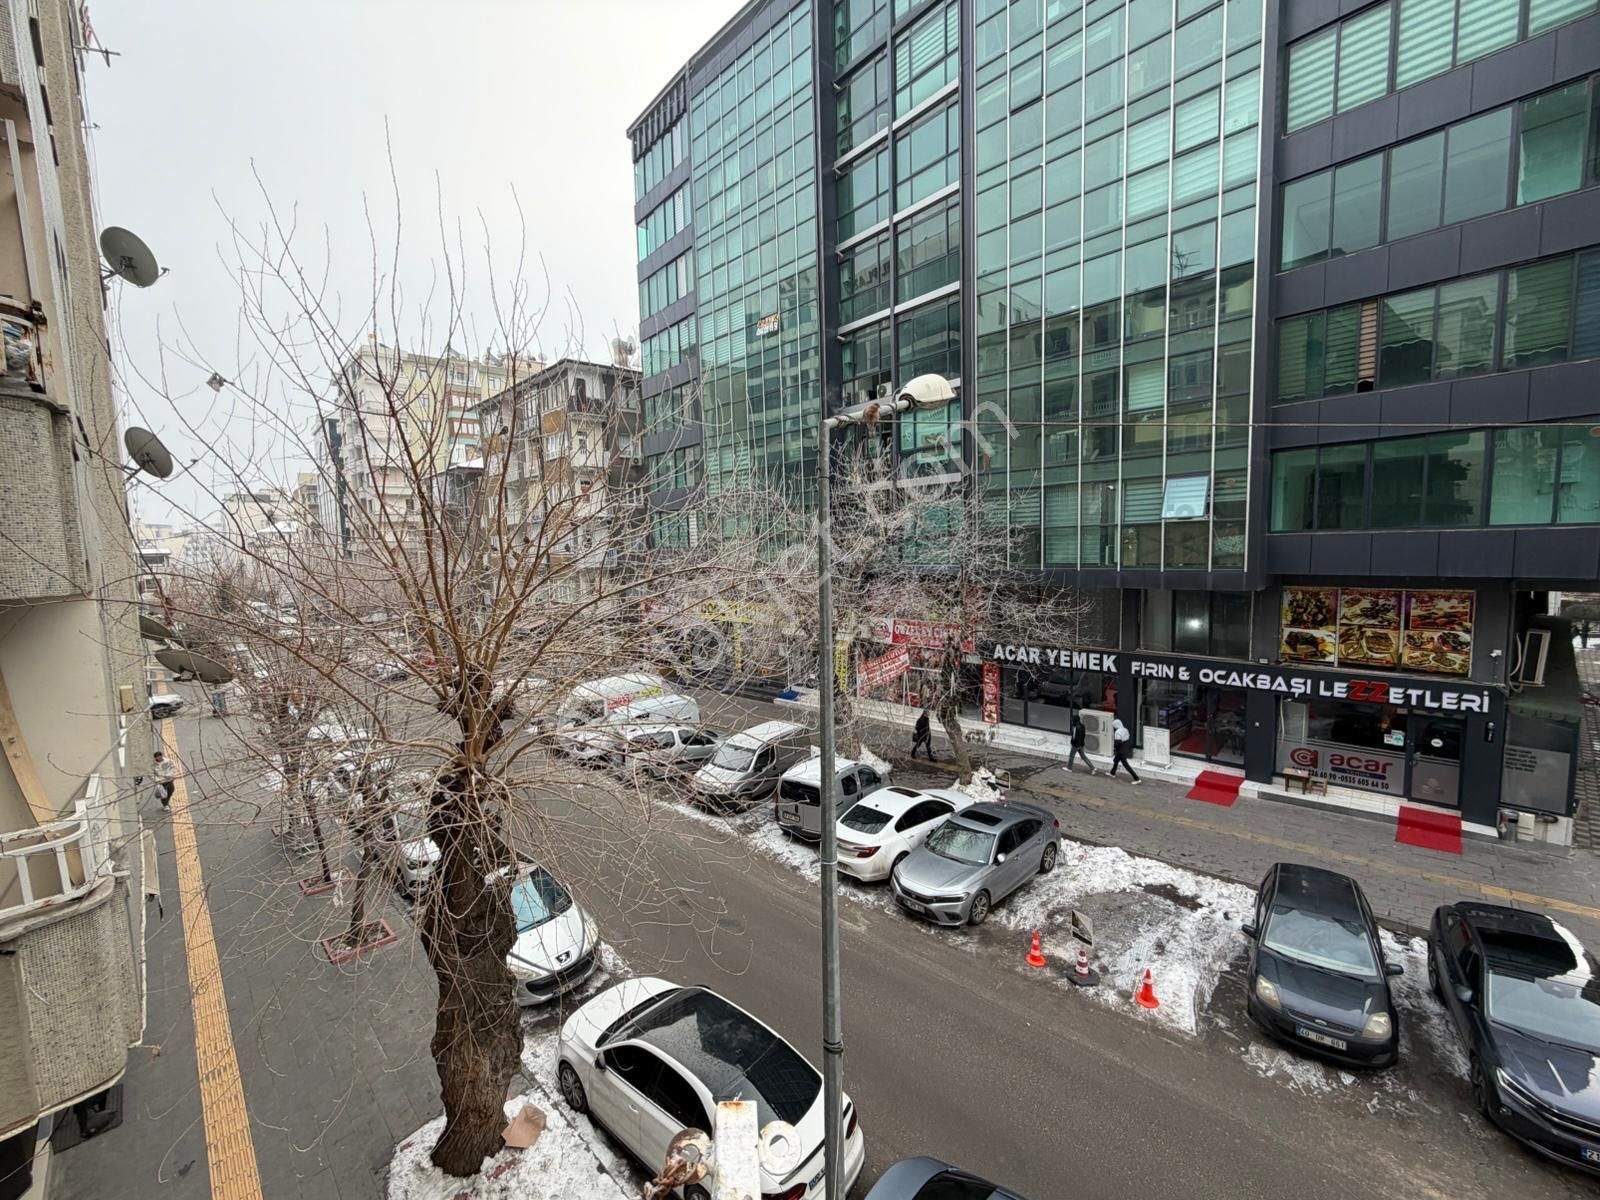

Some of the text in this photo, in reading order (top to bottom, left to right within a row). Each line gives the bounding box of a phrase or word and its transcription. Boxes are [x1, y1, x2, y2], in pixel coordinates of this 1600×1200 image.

[993, 644, 1118, 673] ACAR YEMEK
[1131, 660, 1490, 713] FIRIN & OCAKBAŞI LEZZETLERİ
[1329, 753, 1393, 774] acar
